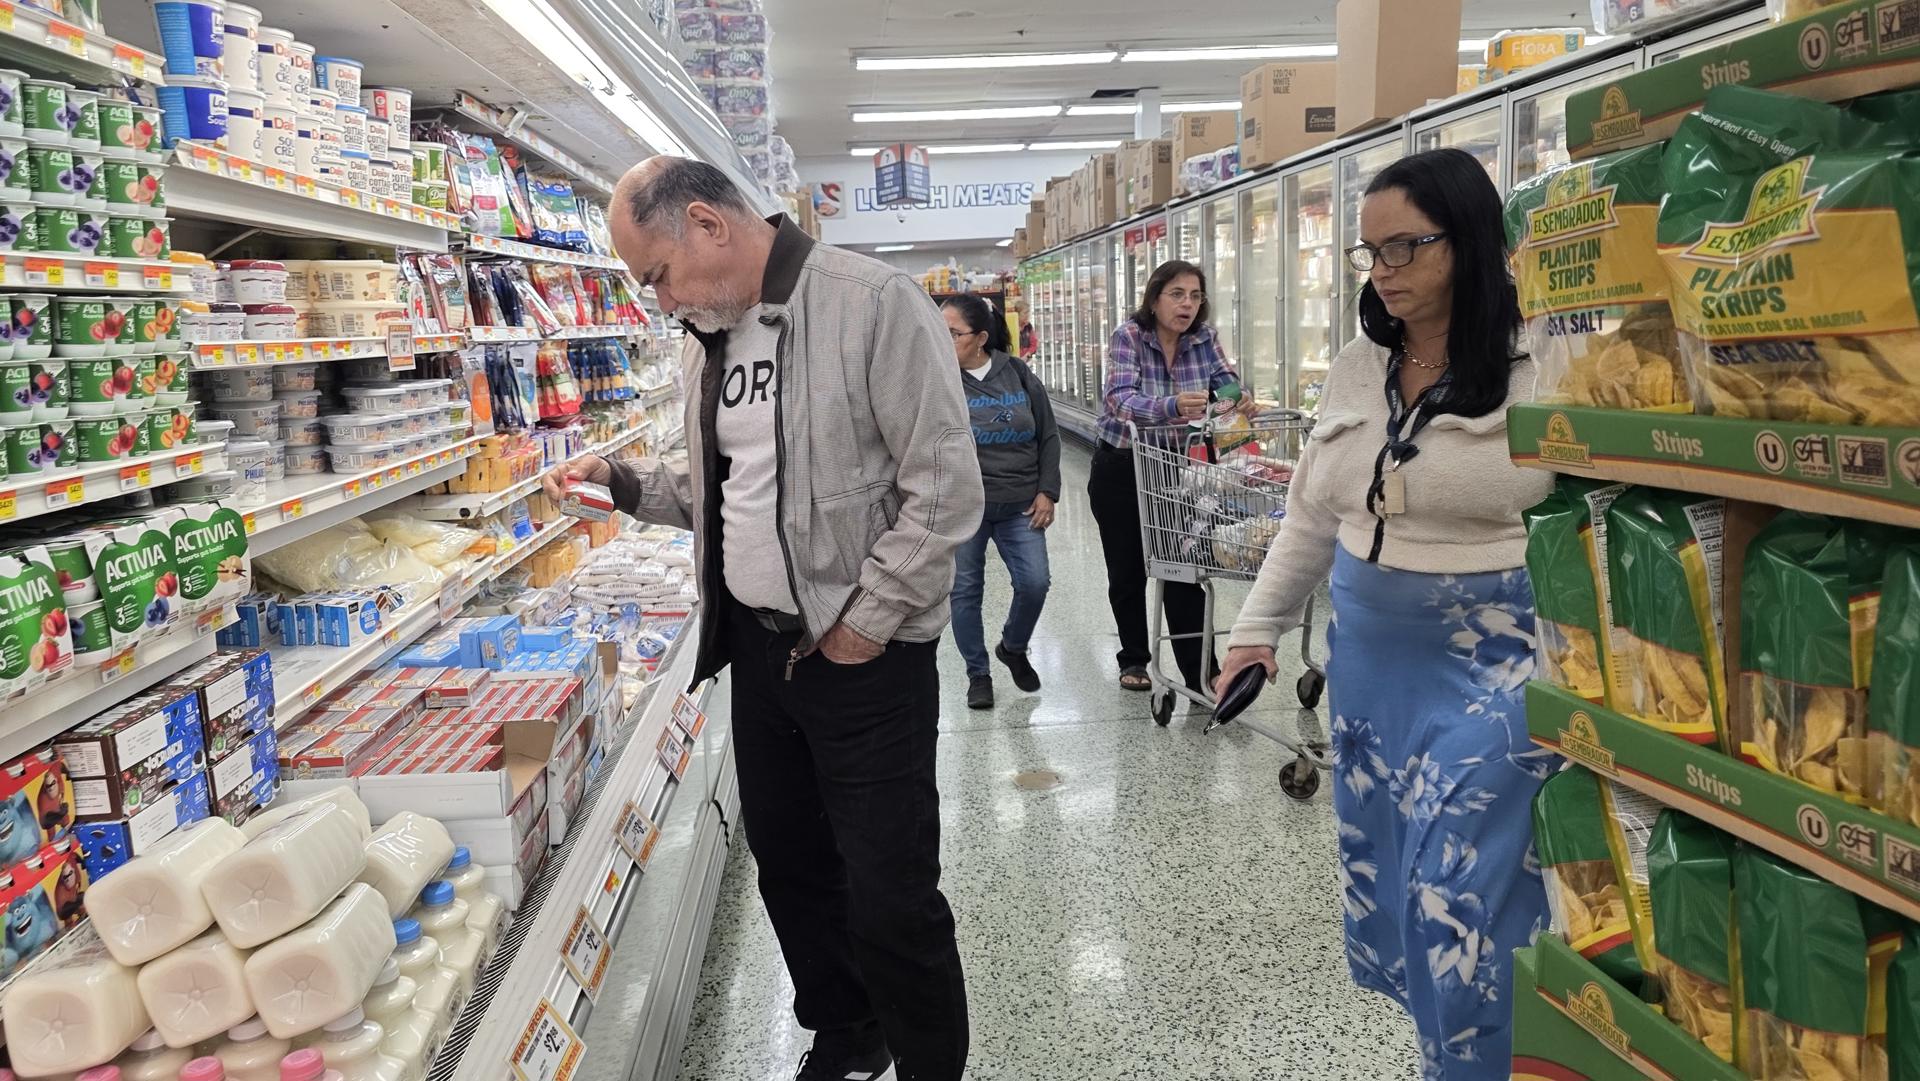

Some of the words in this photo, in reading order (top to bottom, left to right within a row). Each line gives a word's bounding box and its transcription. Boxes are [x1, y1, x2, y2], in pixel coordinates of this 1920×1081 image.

[1629, 6, 1638, 19] 6
[1702, 60, 1751, 90] Strips
[1747, 129, 1769, 147] Easy
[1770, 139, 1797, 156] Open
[855, 186, 948, 212] LUH
[953, 181, 1035, 208] MEATS
[1534, 219, 1542, 233] EL
[1541, 197, 1606, 235] SEMBRADOR
[1707, 235, 1723, 250] EL
[1722, 202, 1809, 254] SEMBRADOR
[1538, 238, 1602, 271] PLANTAIN
[1548, 266, 1596, 292] STRIPS
[1576, 291, 1592, 304] CON
[1591, 288, 1606, 300] SAL
[1701, 286, 1788, 320] STRIPS
[1548, 315, 1567, 336] SEA
[1570, 309, 1605, 335] SALT
[1756, 319, 1784, 334] CON
[1783, 317, 1809, 331] SAL
[1709, 344, 1758, 366] SEA
[1757, 341, 1822, 363] SALT
[721, 360, 777, 409] OR
[969, 390, 1026, 408] arolina
[1548, 444, 1586, 463] SEMBRADOR
[1652, 429, 1705, 460] Strips
[1694, 511, 1715, 521] Datos
[175, 521, 239, 556] ACTIVIA
[105, 544, 167, 584] ACTIVIA
[0, 576, 54, 616] CTIVIA
[109, 581, 131, 593] Supports
[183, 577, 193, 593] 3
[115, 607, 126, 626] 3
[1686, 763, 1743, 806] Strips
[528, 1003, 548, 1035] SPECIAL
[1578, 1003, 1625, 1048] SEMBRADOR
